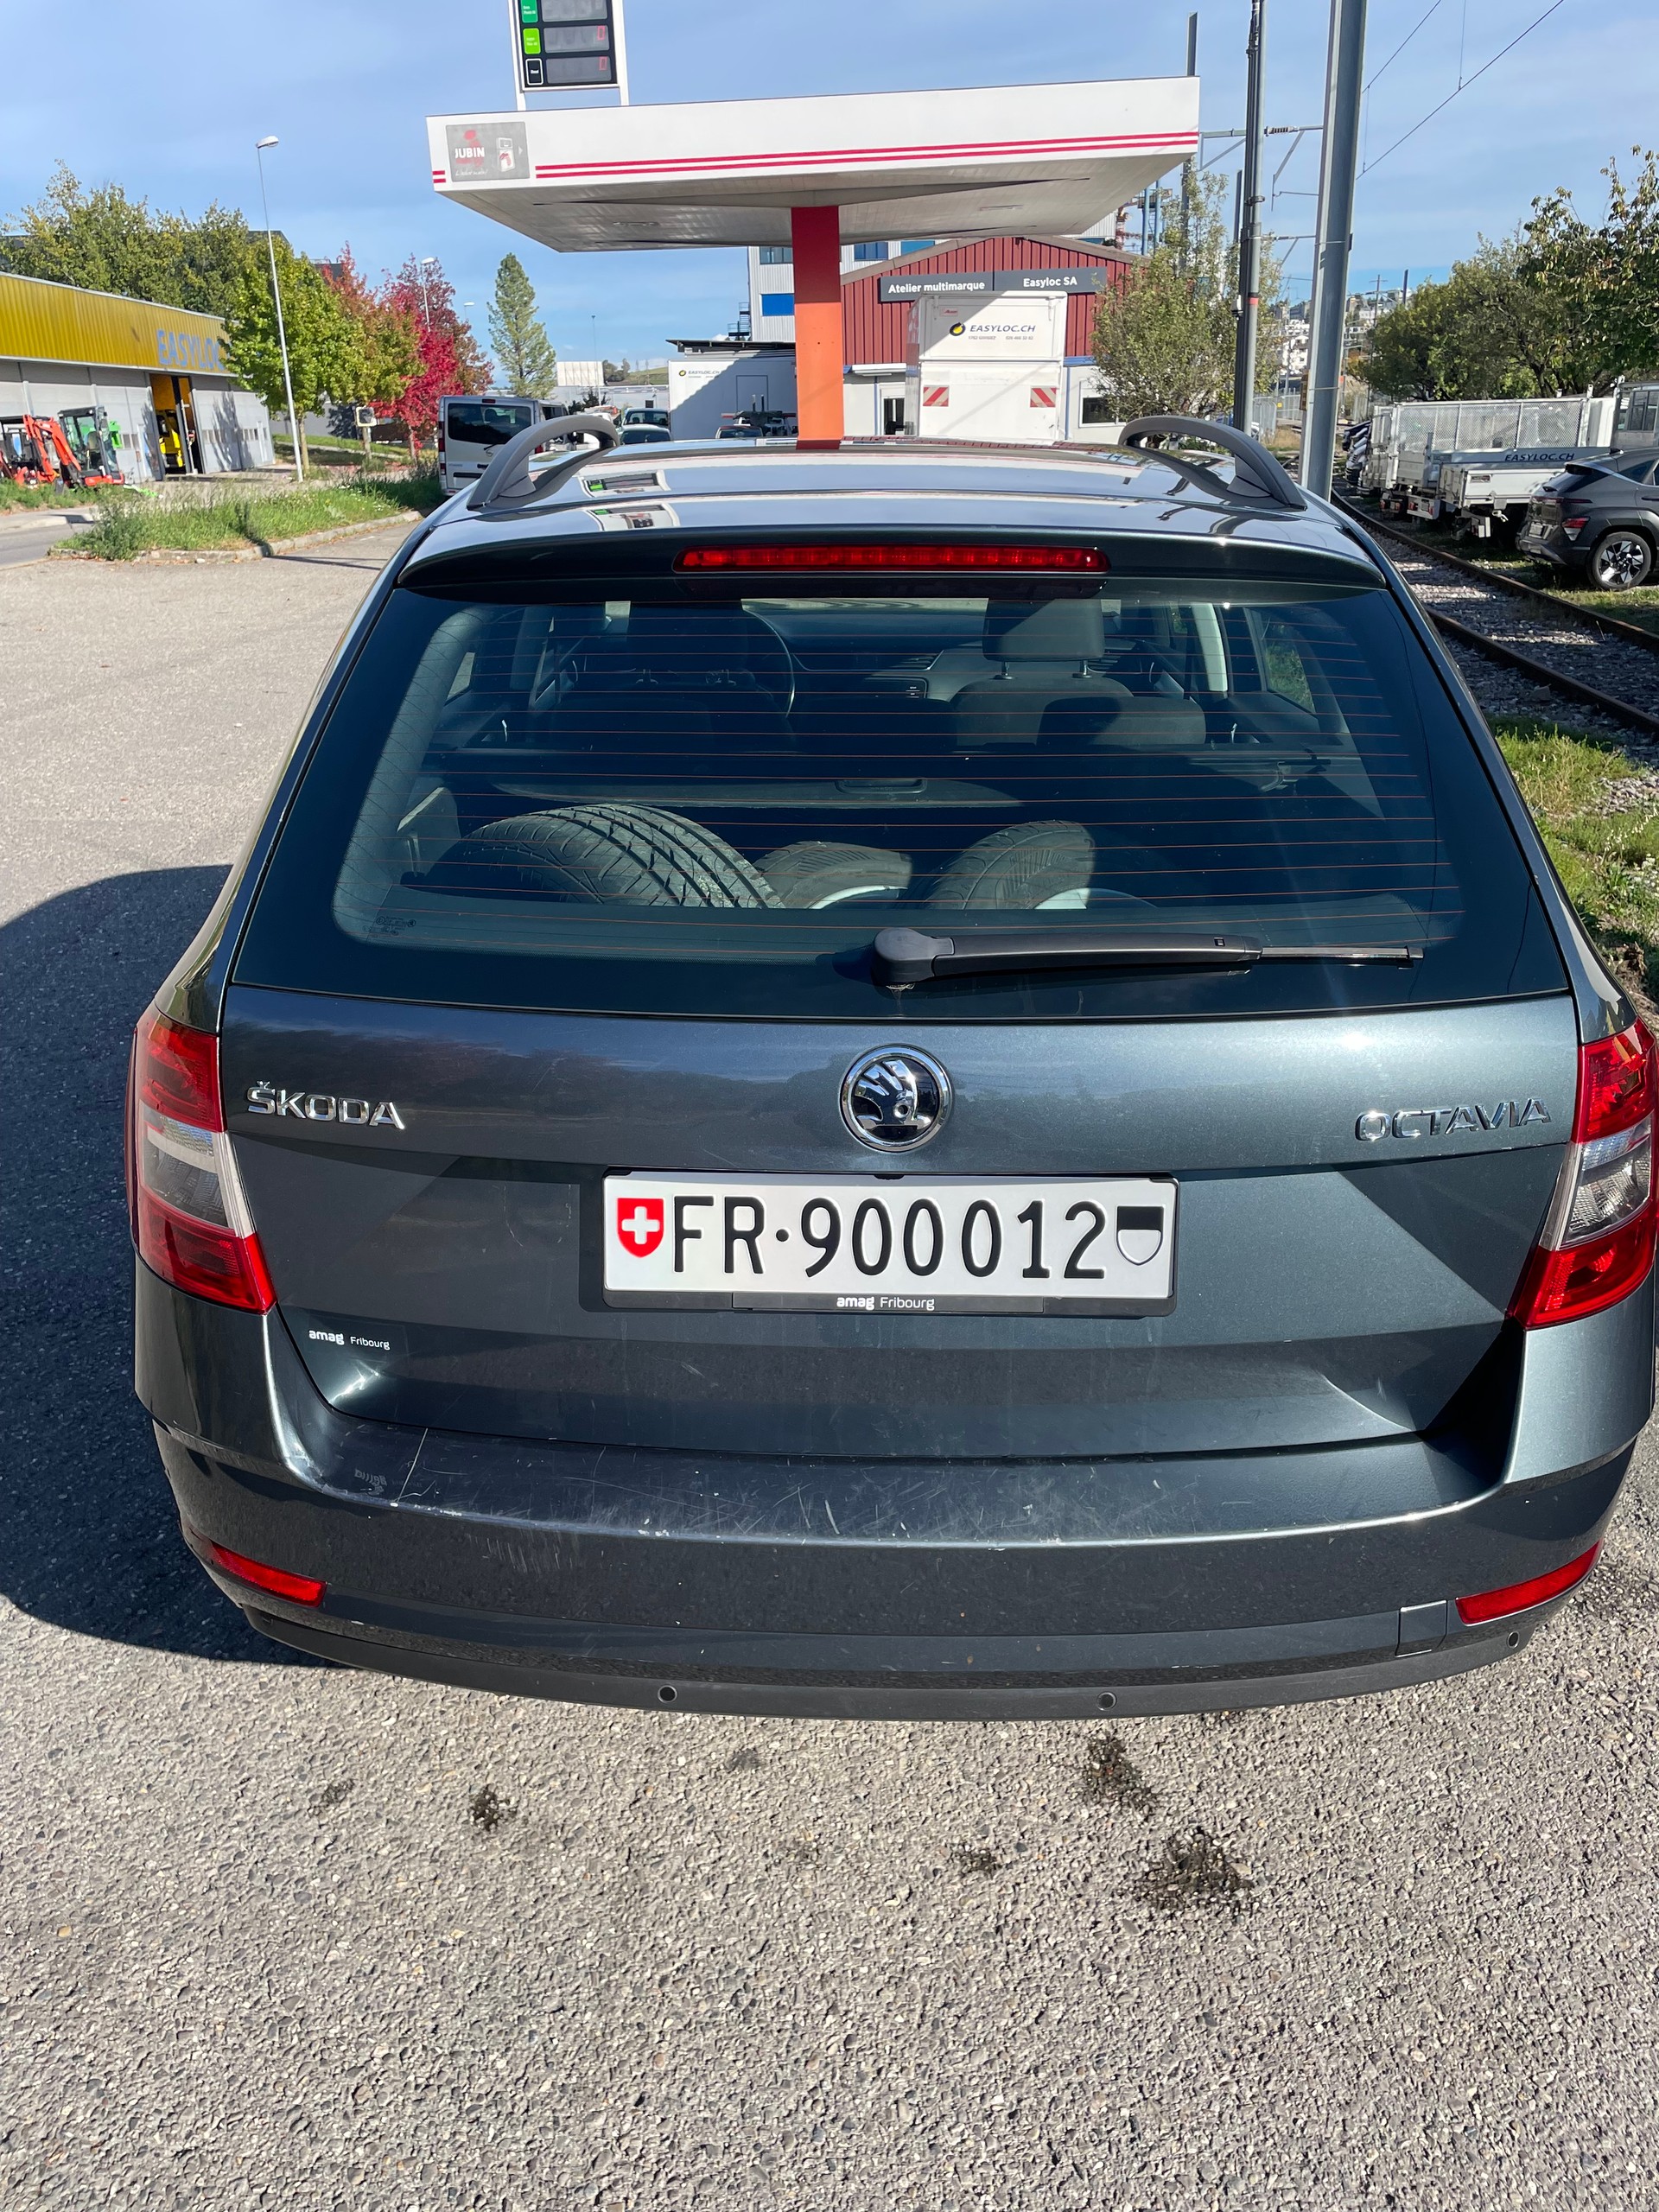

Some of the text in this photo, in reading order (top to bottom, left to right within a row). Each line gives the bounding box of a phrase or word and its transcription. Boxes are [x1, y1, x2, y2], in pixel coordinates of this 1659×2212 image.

[454, 147, 485, 158] JUBIN
[888, 282, 985, 294] Atelier multimarque
[1023, 276, 1077, 289] Easyloc SA
[1504, 453, 1575, 461] EASYLOC.CH
[247, 1080, 405, 1130] ŠKODA
[1355, 1098, 1552, 1141] OCTAVIA
[836, 1297, 935, 1311] amag Fribourg
[308, 1330, 391, 1351] amag Fribourg
